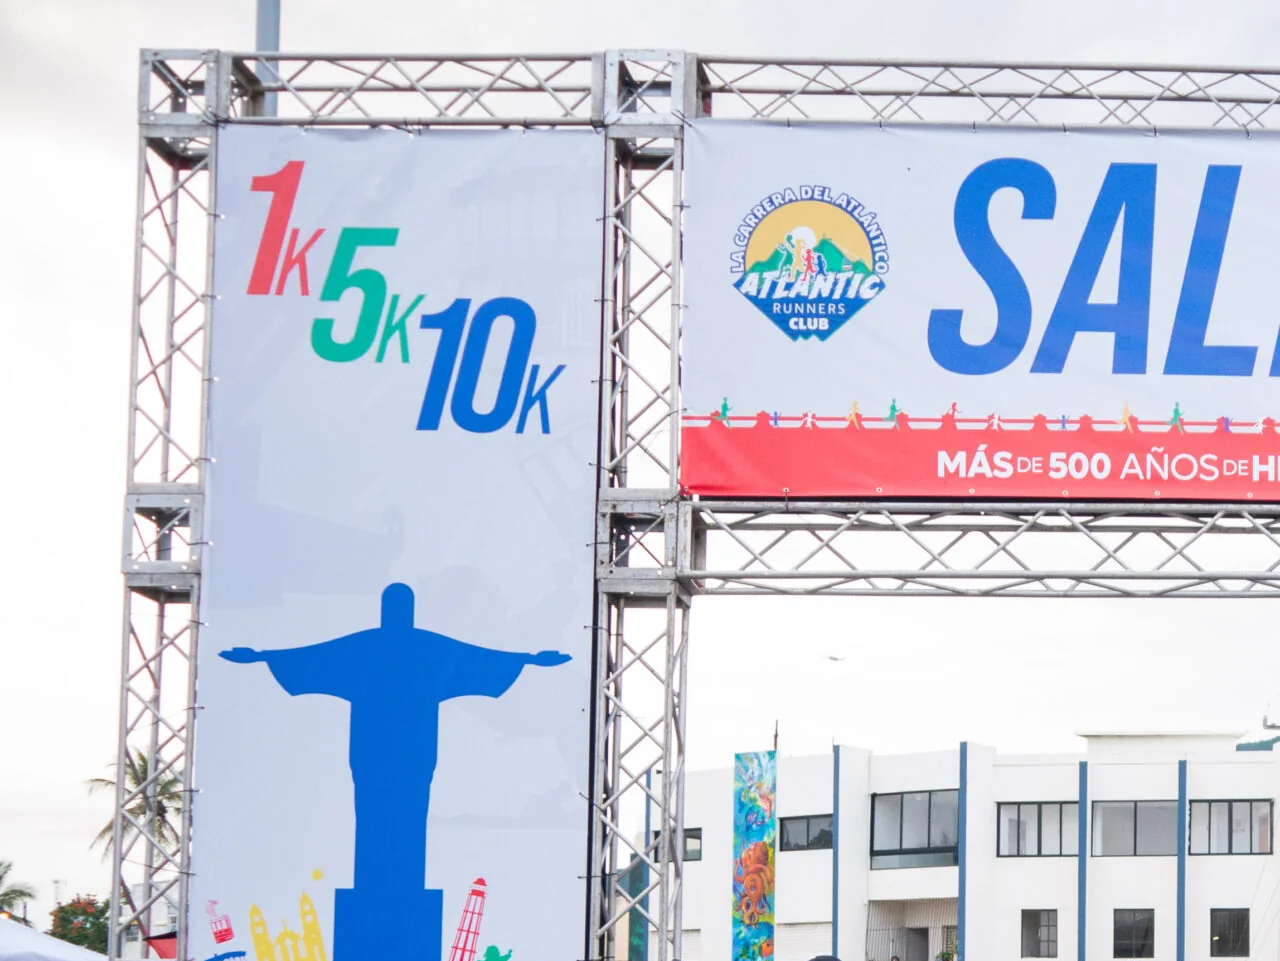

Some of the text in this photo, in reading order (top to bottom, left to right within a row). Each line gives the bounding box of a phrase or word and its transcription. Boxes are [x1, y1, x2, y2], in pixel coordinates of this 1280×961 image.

[731, 185, 889, 274] LA CARRERA DEL ATLÁNTICO
[246, 160, 567, 434] 1K 5K 10K
[739, 271, 881, 299] ATLANTIC
[773, 303, 846, 314] RUNNERS
[789, 317, 829, 330] CLUB
[937, 444, 1013, 479] MÁS
[1017, 457, 1043, 473] DE
[1048, 452, 1111, 480] 500
[1119, 446, 1220, 481] AÑOS
[1223, 459, 1249, 476] DE
